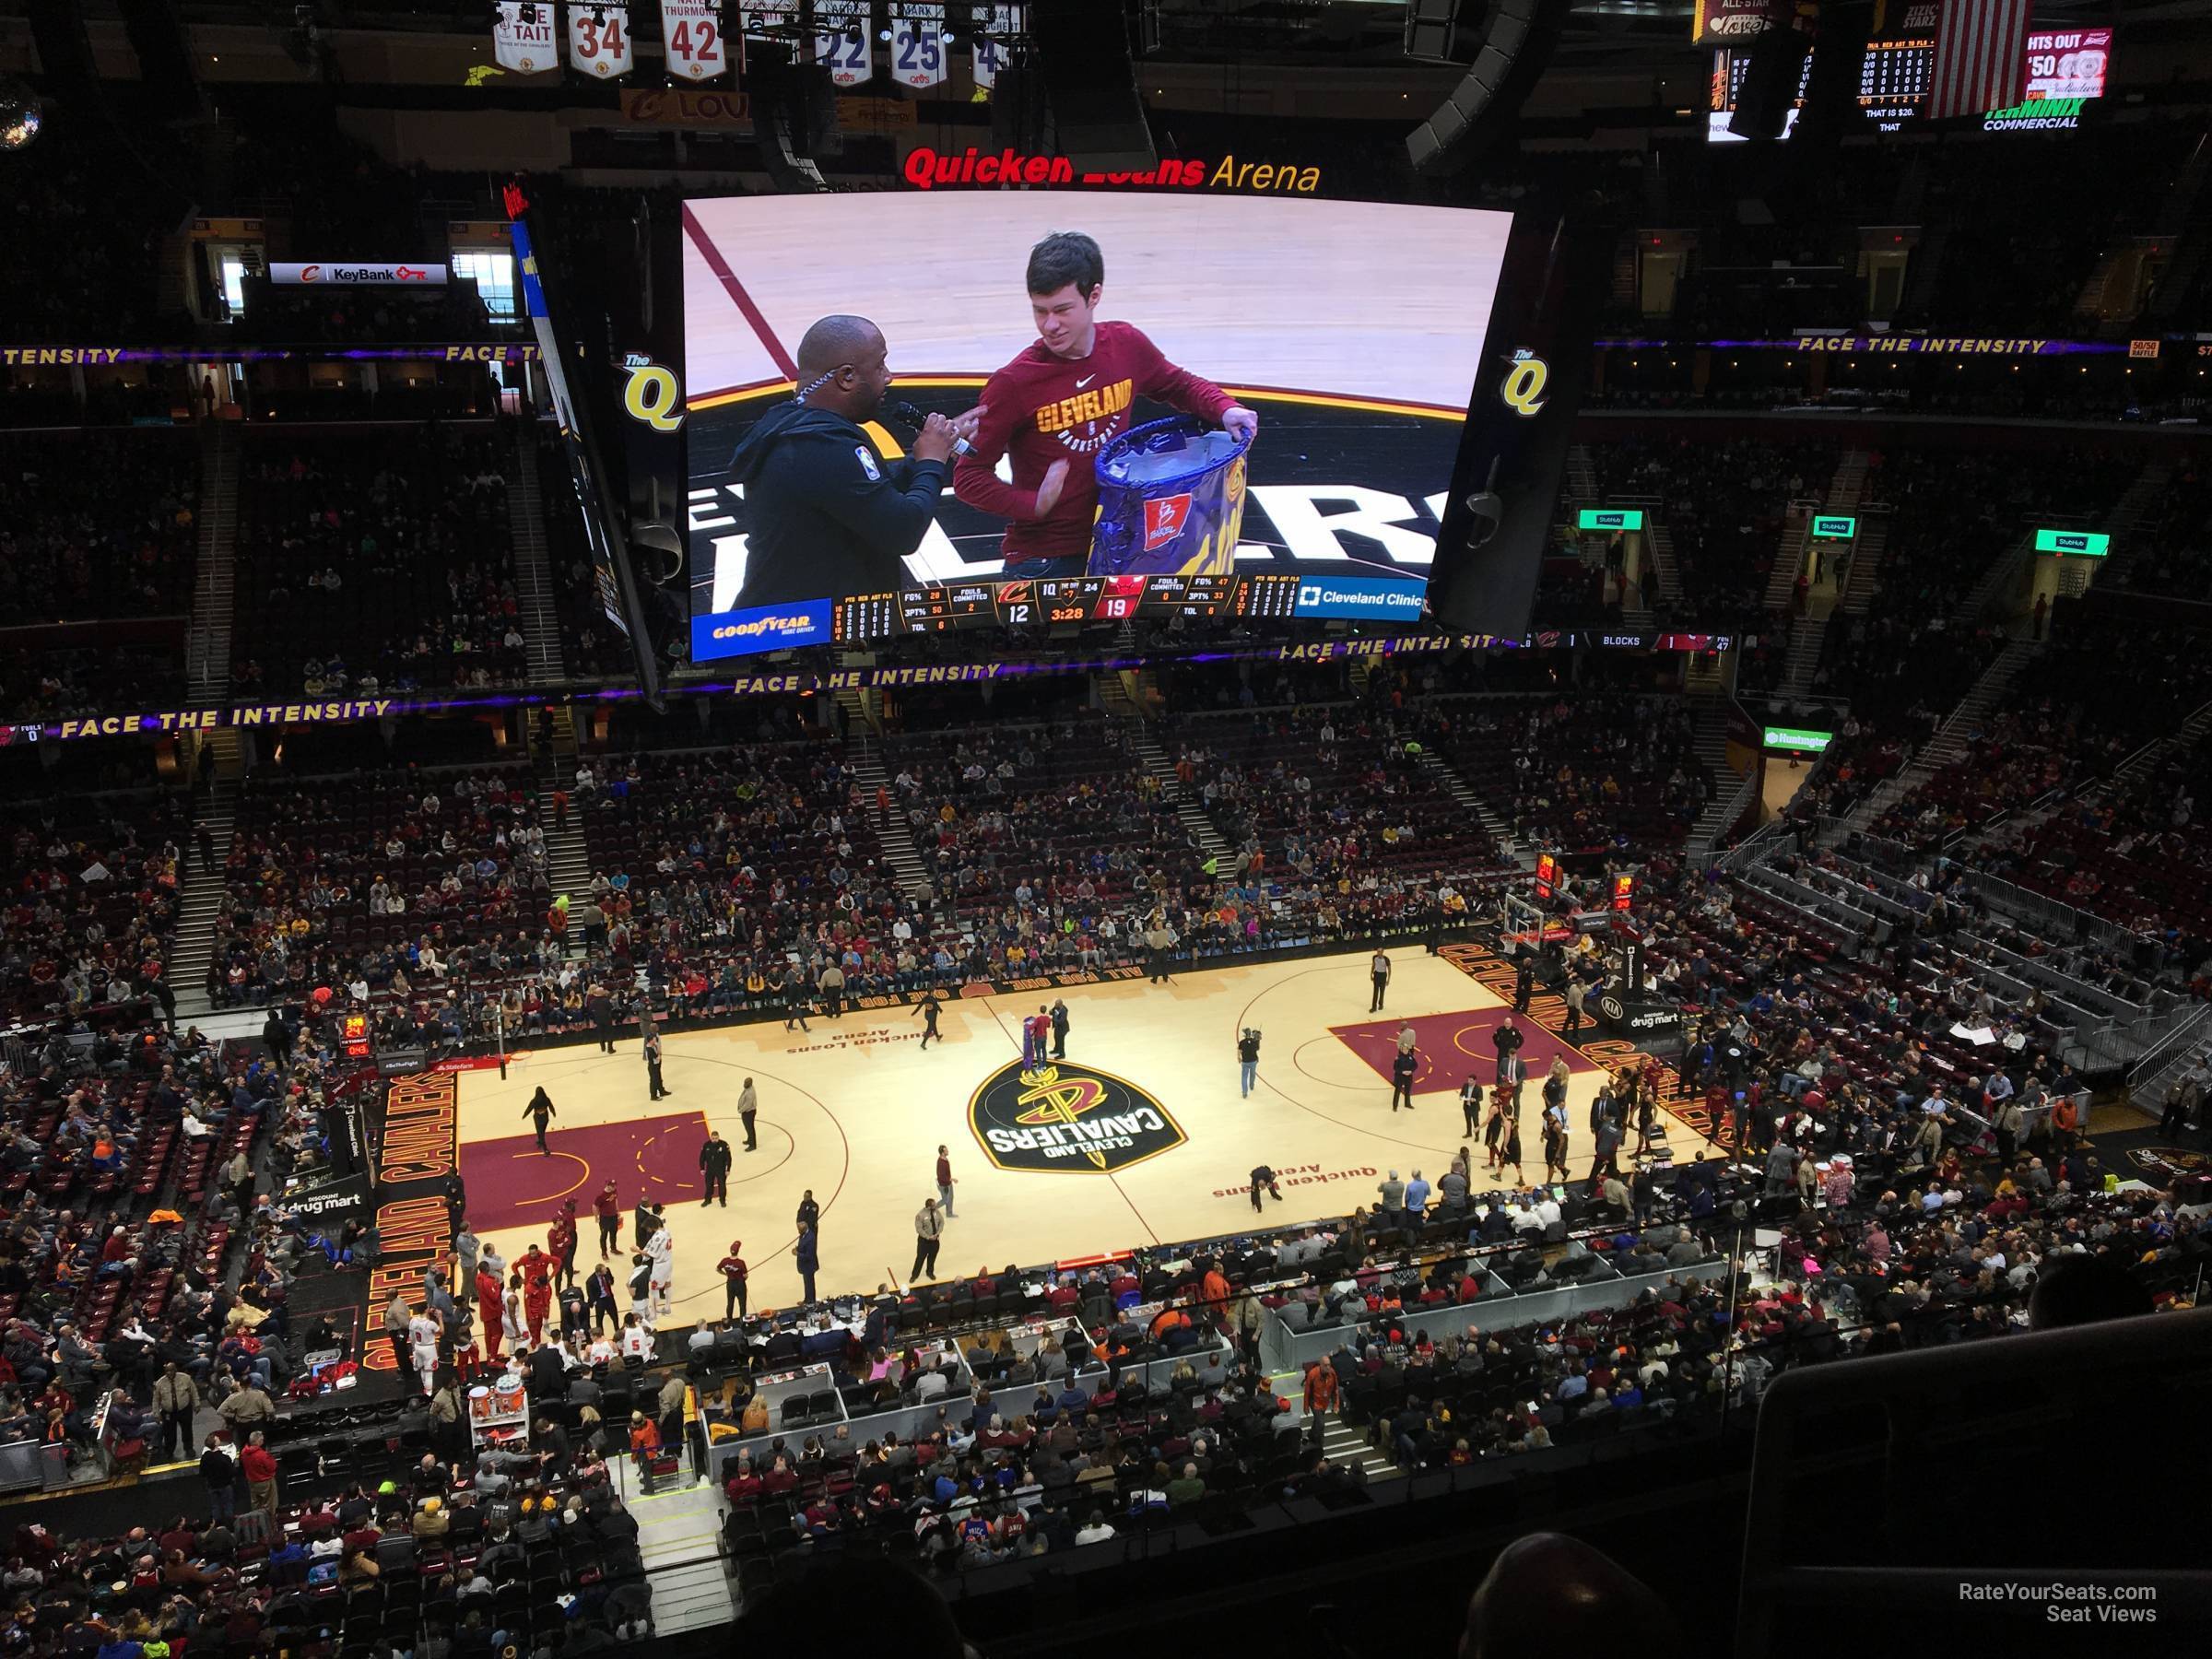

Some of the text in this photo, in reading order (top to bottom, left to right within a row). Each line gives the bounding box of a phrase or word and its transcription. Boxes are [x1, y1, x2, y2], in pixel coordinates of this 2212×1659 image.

[516, 7, 547, 24] JE
[512, 26, 551, 41] TAIT
[576, 17, 625, 59] 34
[671, 20, 718, 61] 42
[2055, 34, 2082, 49] OUT
[898, 29, 940, 70] 25
[1865, 109, 1887, 118] THAT
[1898, 108, 1915, 117] $20.
[1880, 123, 1900, 132] THAT
[1983, 117, 2078, 131] COMMERCIAL
[903, 147, 1320, 192] Quicken Arena
[334, 268, 394, 282] KeyBank
[1798, 337, 2157, 354] FACE THE INTENSITY 50/50
[446, 347, 508, 361] FACE
[626, 354, 651, 366] The
[1514, 349, 1534, 359] The
[1504, 359, 1547, 415] Q
[623, 366, 684, 431] Q
[1036, 378, 1132, 433] CLEVELAND
[1194, 577, 1229, 586] FG% 47
[960, 588, 981, 597] FOULS
[1043, 582, 1099, 596] 1Q 24
[1064, 590, 1074, 599] -7
[953, 594, 988, 603] COMMITTED
[1162, 593, 1169, 601] 0
[1188, 592, 1209, 601] 3PT%
[1323, 591, 1422, 606] Cleveland Clinic
[904, 607, 927, 618] 3PT%
[968, 603, 974, 612] 2
[1010, 605, 1029, 623] 12
[1051, 608, 1084, 620] 3:28
[1108, 599, 1126, 617] 19
[1183, 606, 1215, 616] TOL 6
[713, 616, 810, 640] GOODYEAR
[912, 621, 944, 632] TOL 6
[1346, 640, 1386, 655] THE
[1604, 636, 1641, 645] BLOCKS
[1716, 642, 1729, 651] 47
[735, 675, 799, 694] FACE
[872, 664, 1001, 686] INTENSITY
[61, 699, 392, 738] FACE THE INTENSITY
[28, 730, 37, 741] 0
[1056, 966, 1144, 984] ALL FOR
[857, 994, 901, 1008] FOR
[1605, 1002, 1619, 1016] KIA
[1631, 1012, 1679, 1029] drug mart
[346, 1027, 361, 1036] 24
[832, 1029, 889, 1041] Arena
[786, 1041, 846, 1054] Loans
[380, 1071, 455, 1183] CAVALIERS
[986, 1108, 1165, 1152] CAVALIERS
[348, 1115, 360, 1158] Cleveland Clinic
[1042, 1135, 1134, 1159] CLEVELAND
[1287, 1167, 1377, 1187] Quicken
[288, 1194, 361, 1215] drug mart
[308, 1193, 339, 1202] DISCOUNT
[632, 1340, 640, 1351] 5
